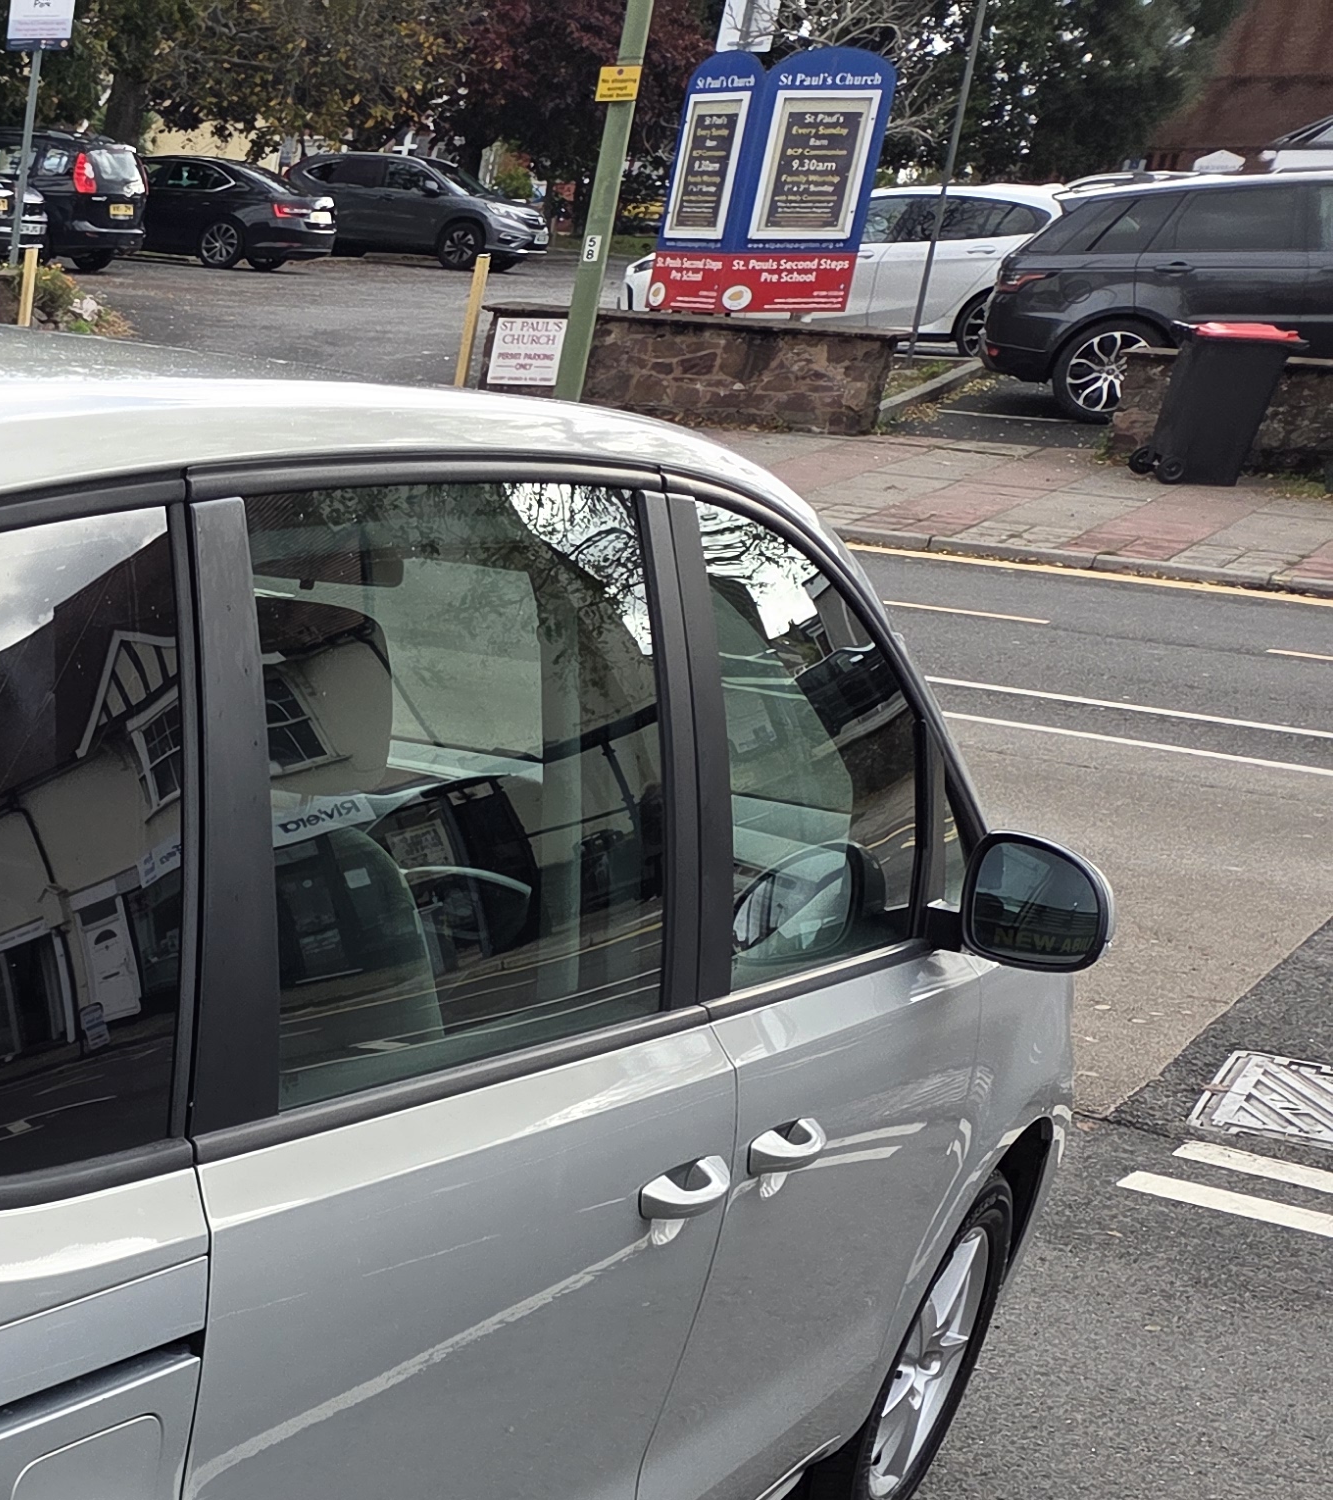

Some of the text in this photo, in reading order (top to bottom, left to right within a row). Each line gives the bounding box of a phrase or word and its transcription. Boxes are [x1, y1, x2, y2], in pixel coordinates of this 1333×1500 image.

[779, 72, 882, 86] St Paul's Church
[792, 159, 836, 171] 9.30am
[779, 259, 819, 270] Second
[820, 259, 849, 271] Steps
[760, 271, 816, 283] Pre School
[500, 321, 516, 332] ST
[502, 334, 556, 346] CHURCH
[993, 927, 1056, 952] NEW
